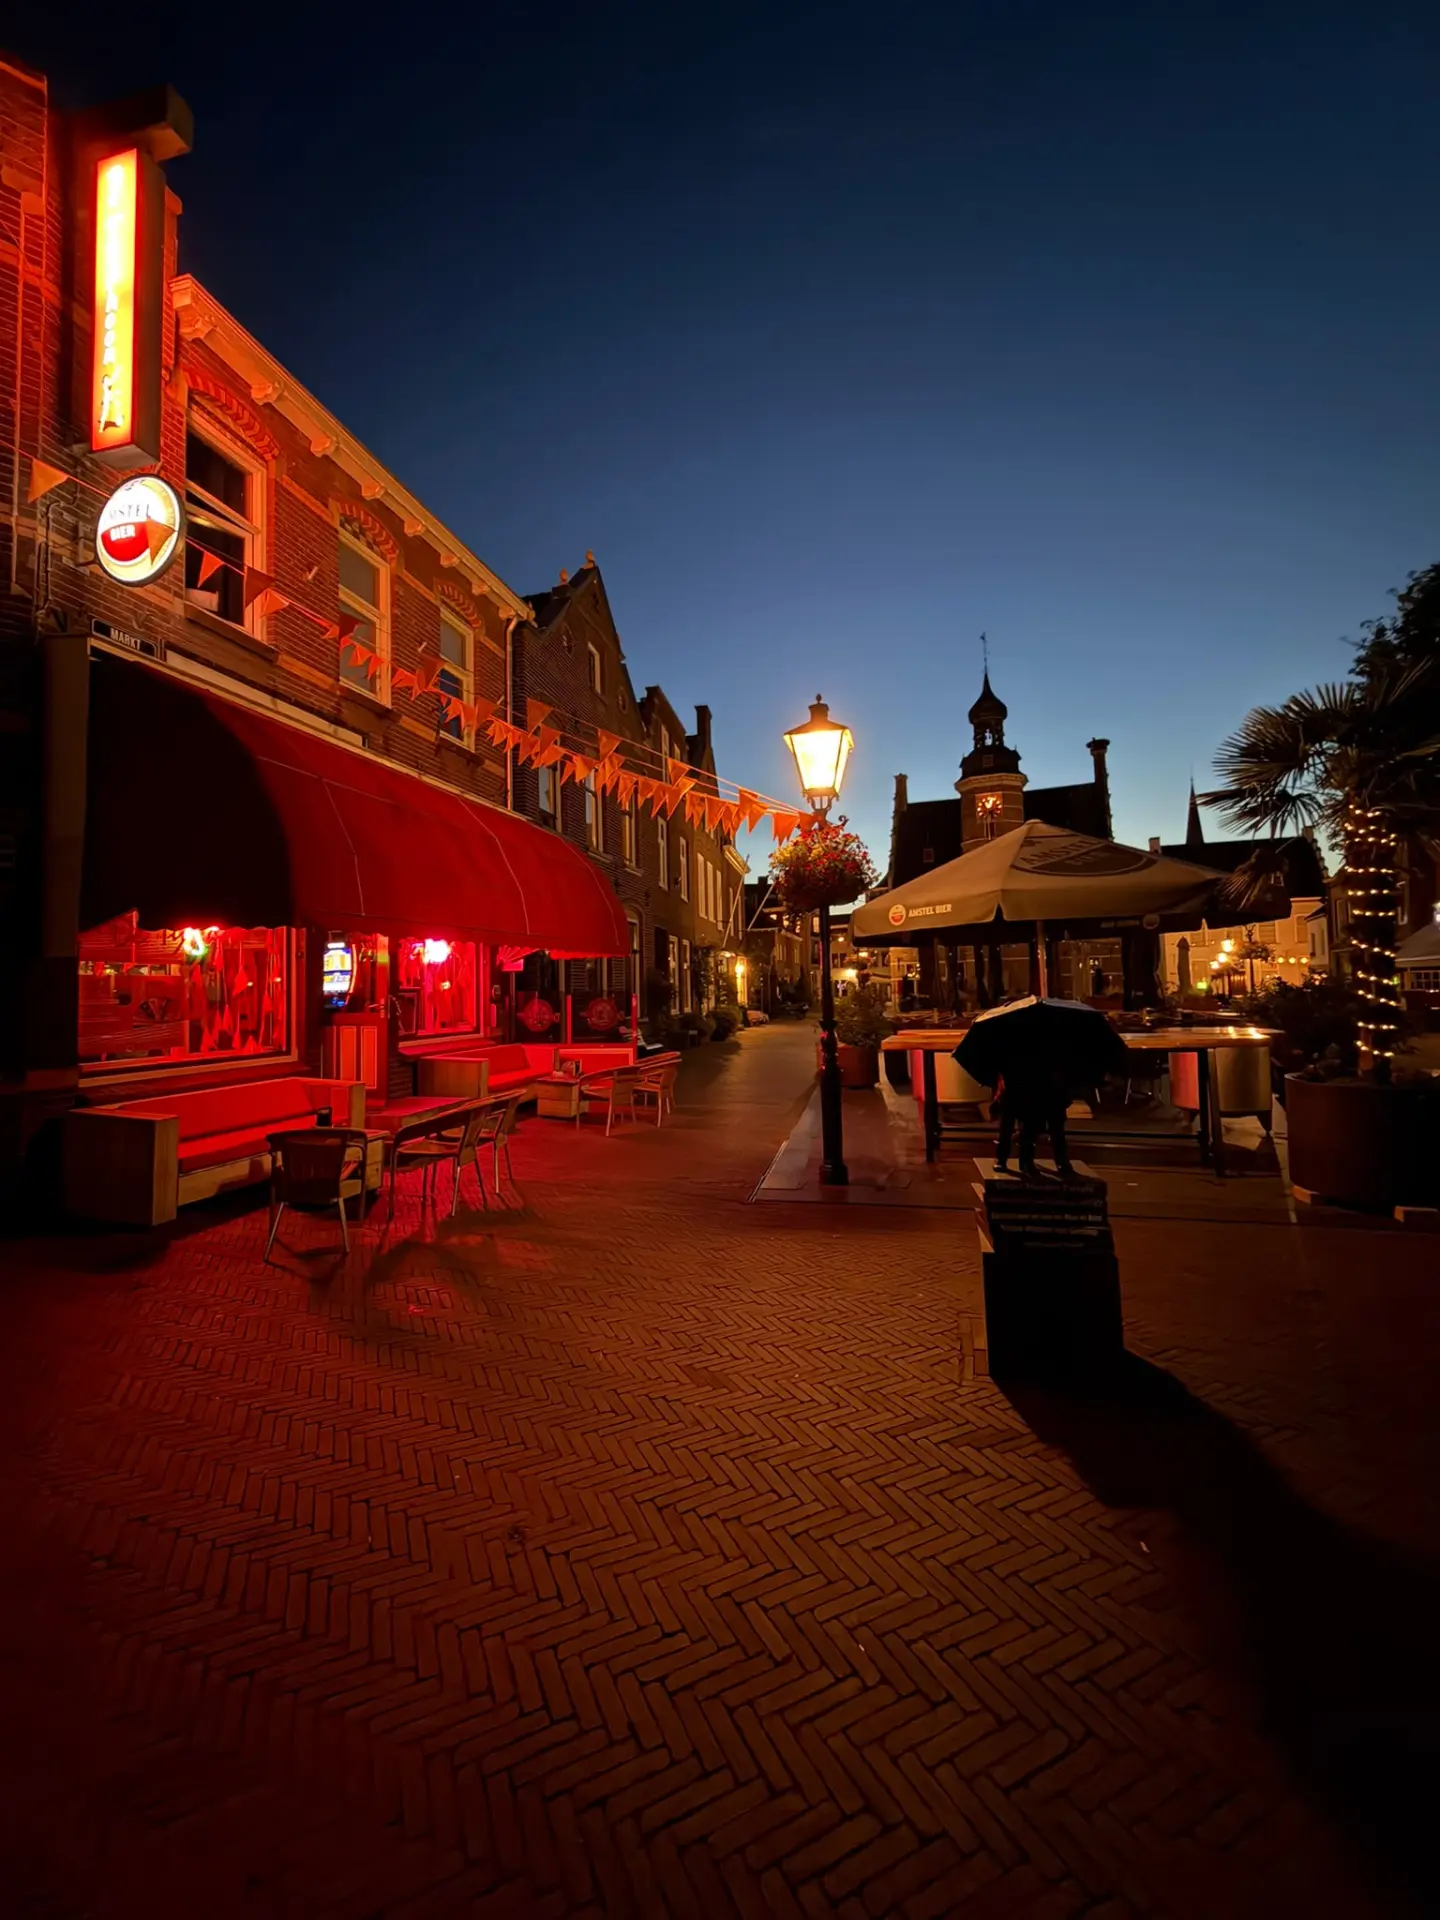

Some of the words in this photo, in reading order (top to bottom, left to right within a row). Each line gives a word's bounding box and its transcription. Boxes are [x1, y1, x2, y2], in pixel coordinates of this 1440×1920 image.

[103, 503, 151, 520] STEL
[110, 627, 141, 651] MARKT
[908, 906, 934, 918] AMSTEL
[935, 903, 952, 914] BIER
